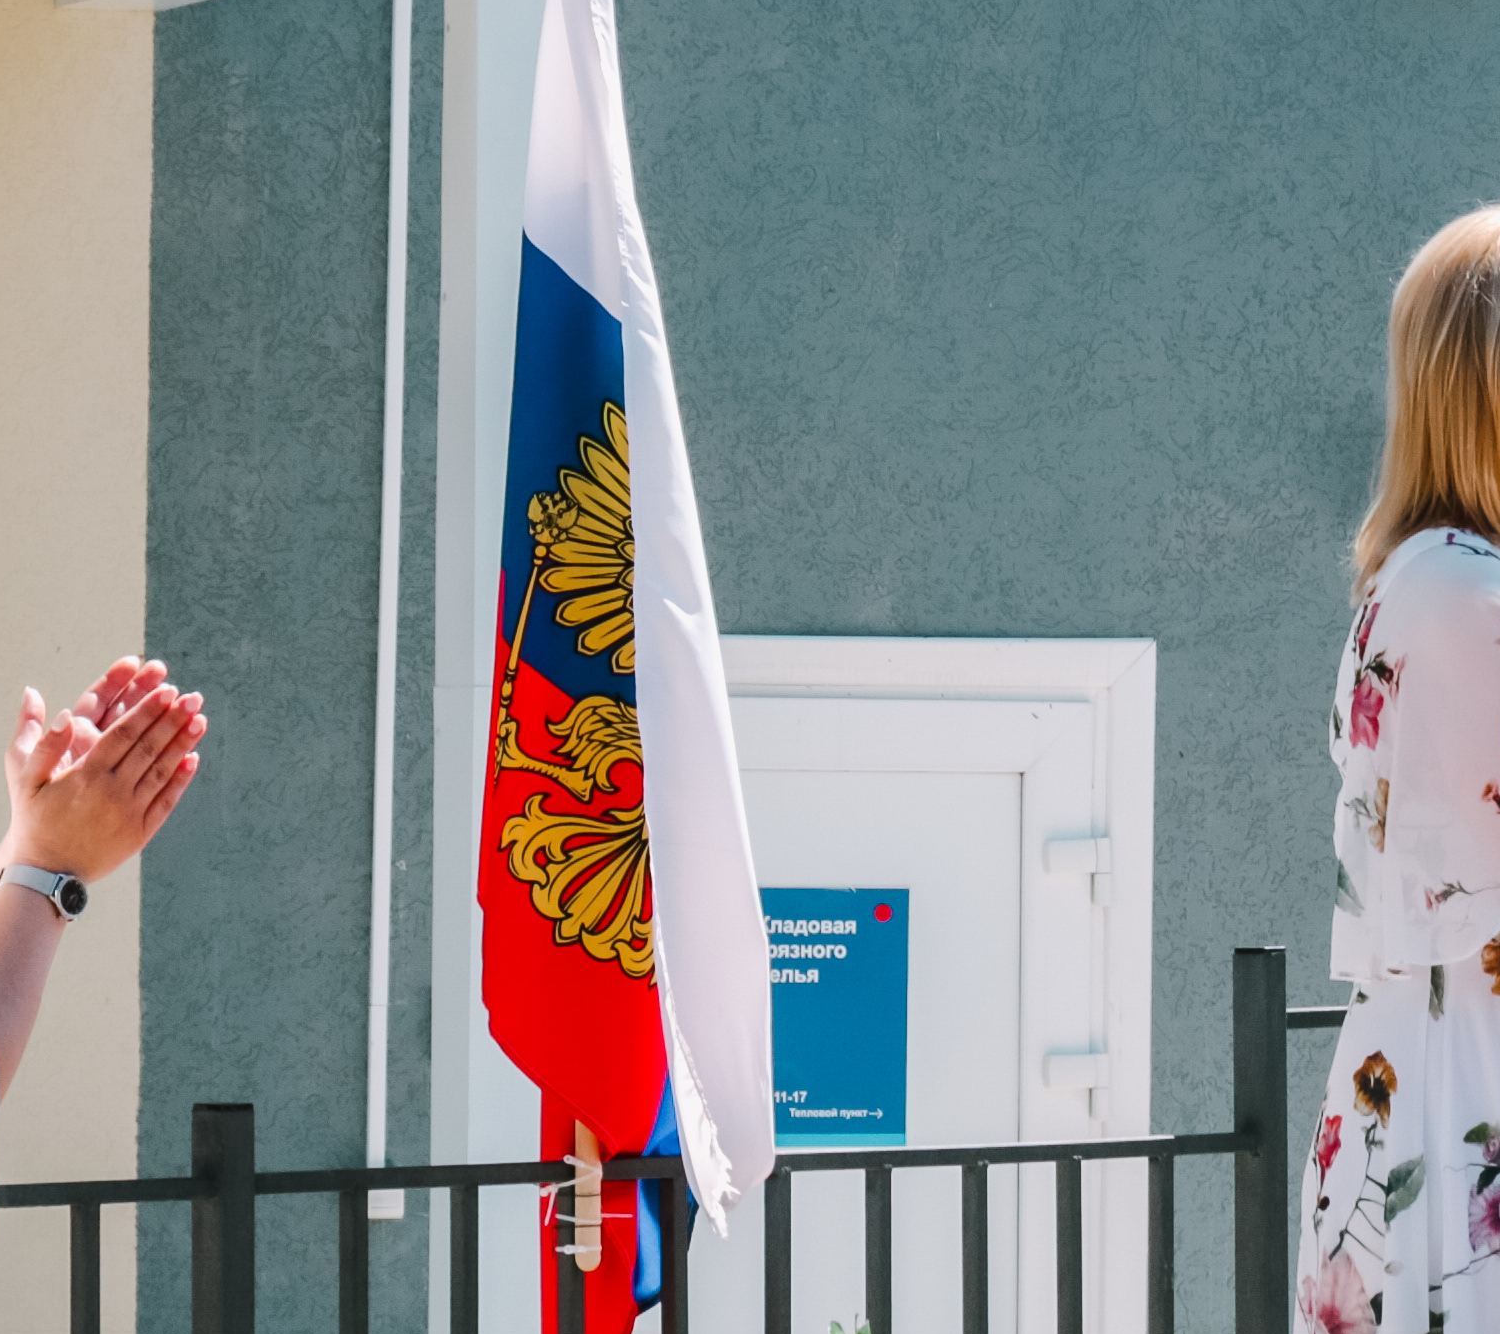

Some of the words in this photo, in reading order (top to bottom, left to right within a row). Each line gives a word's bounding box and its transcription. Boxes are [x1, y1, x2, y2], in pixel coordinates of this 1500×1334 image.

[769, 944, 848, 960] рязного
[769, 968, 820, 984] елья
[789, 1107, 838, 1118] Тепловой
[839, 1109, 869, 1120] пункт
